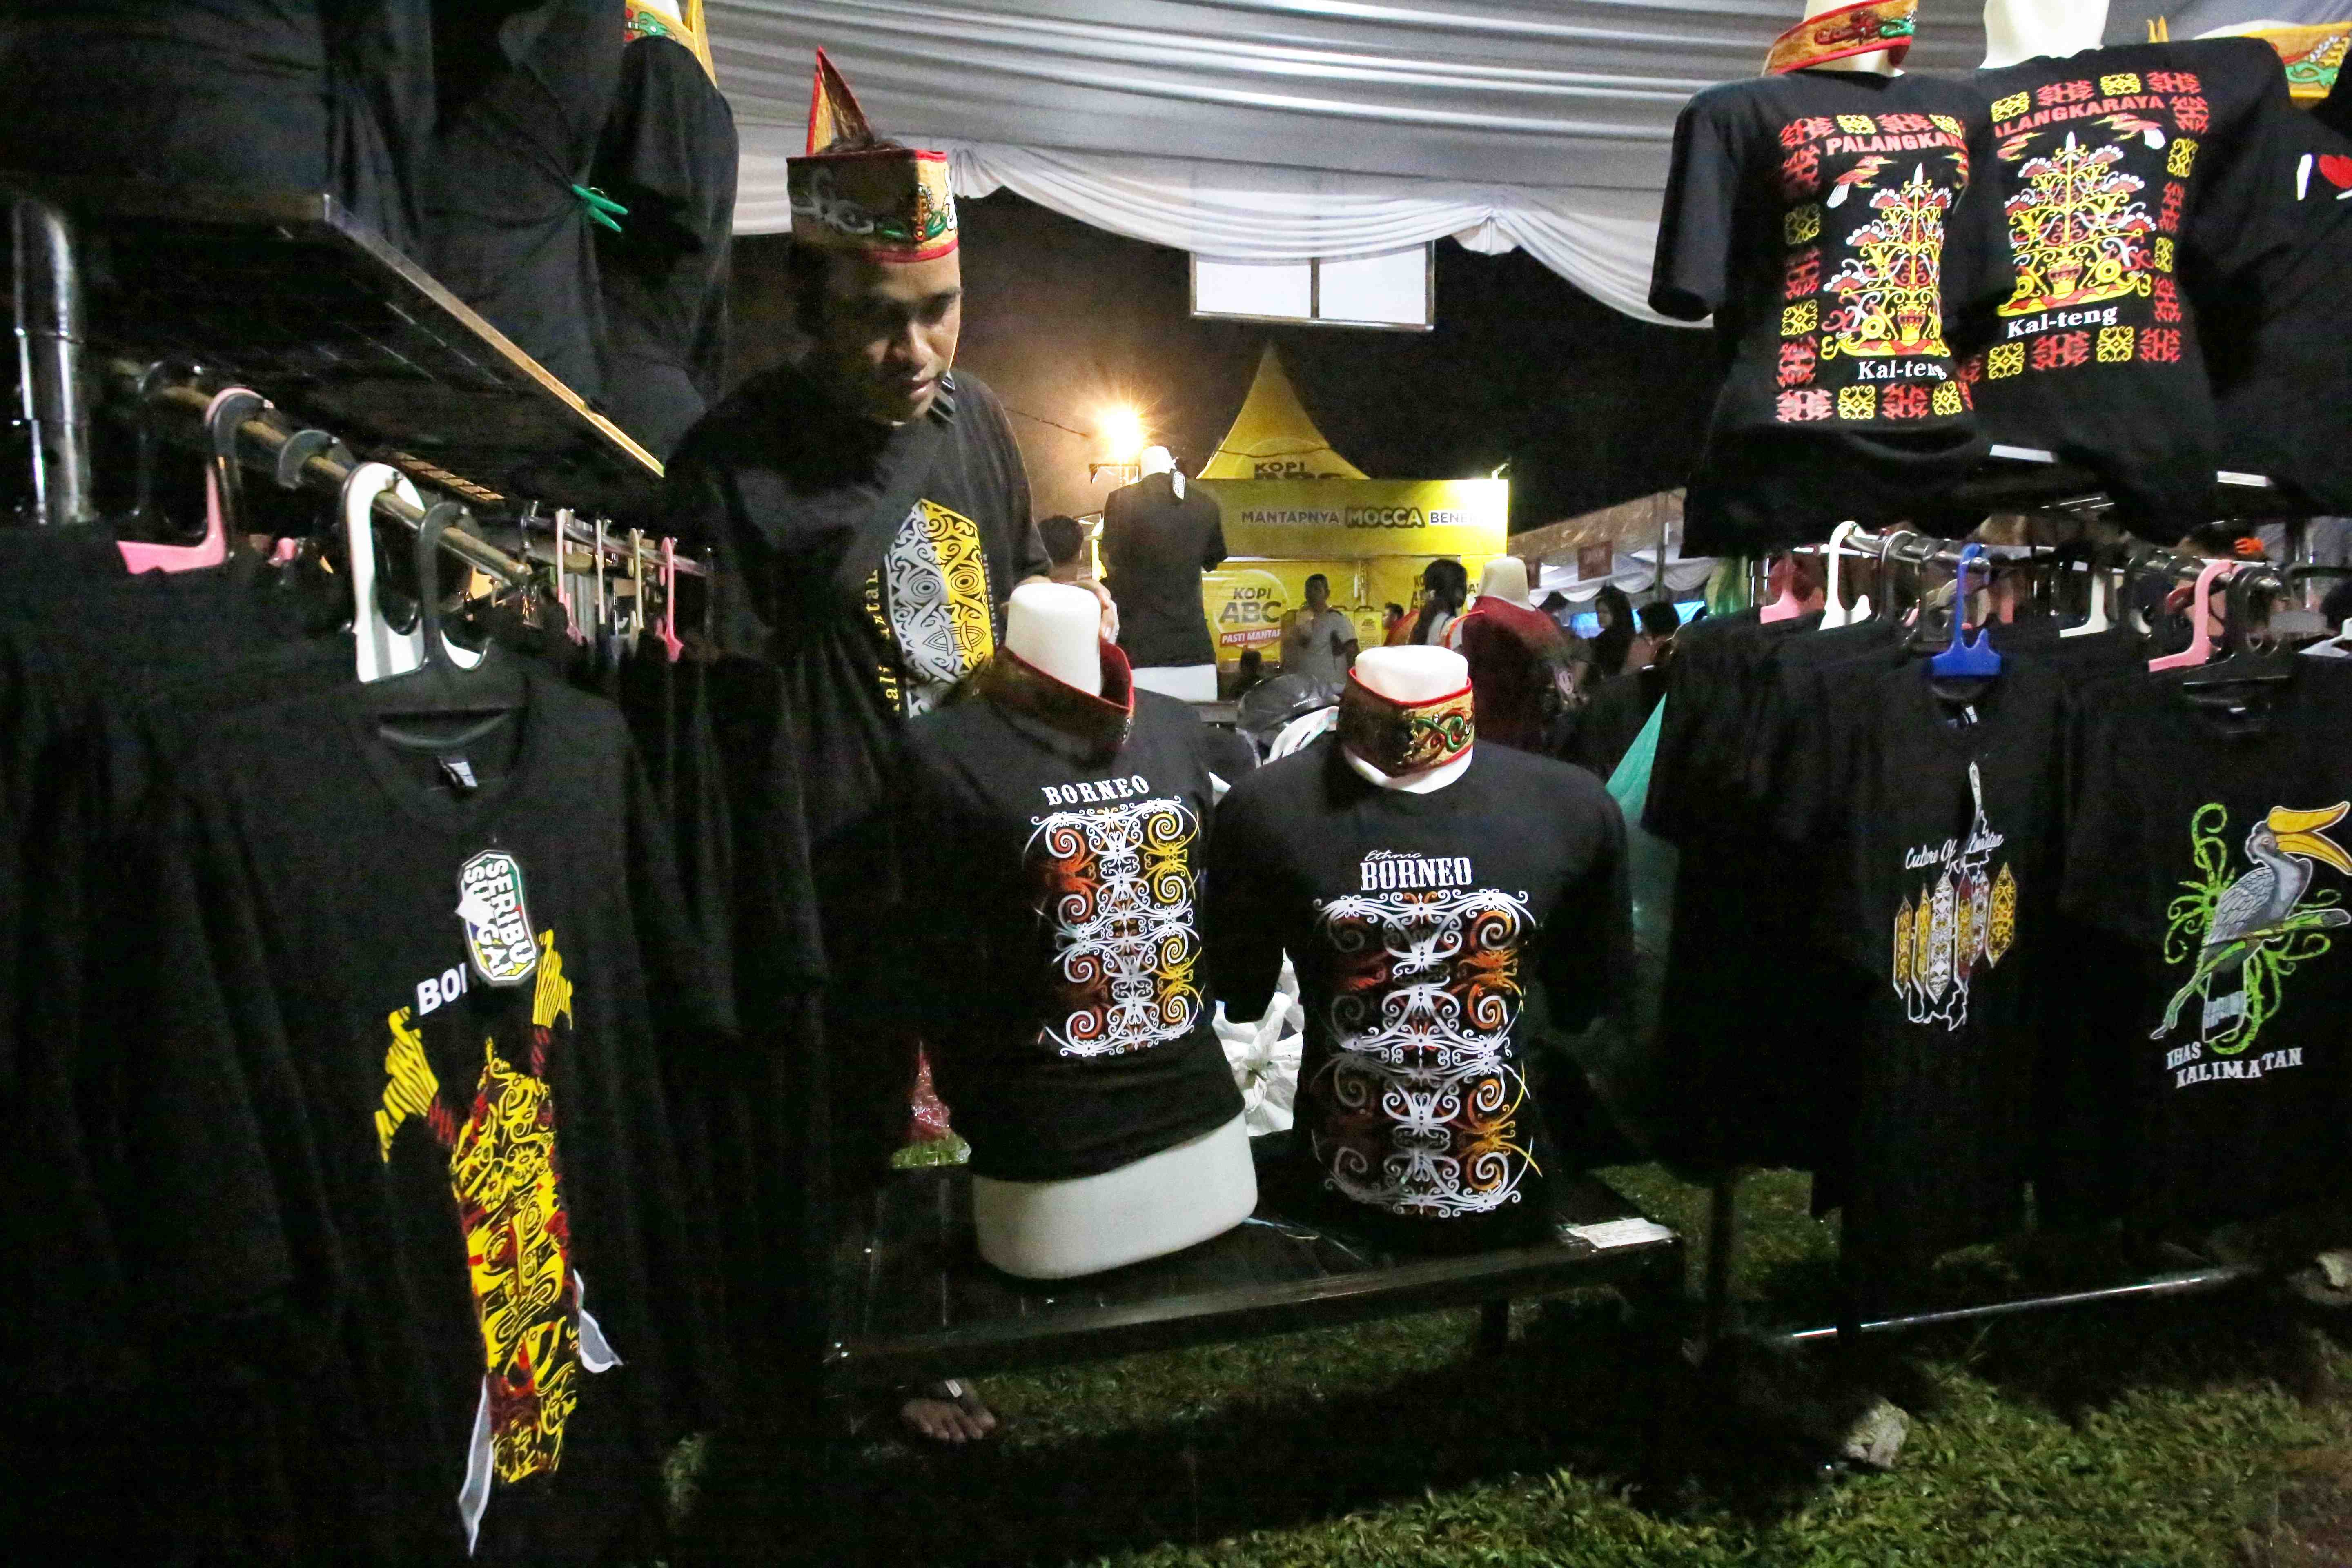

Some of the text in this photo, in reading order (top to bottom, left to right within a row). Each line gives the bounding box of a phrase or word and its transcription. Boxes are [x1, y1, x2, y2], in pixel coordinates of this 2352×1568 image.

[1994, 95, 2165, 138] LANGKARAYA
[2007, 306, 2118, 339] Kal-teng
[1254, 462, 1305, 473] KOPI
[1241, 508, 1475, 528] MANTAPNYA MOCCA BENE
[1234, 588, 1272, 599] KOPI
[1218, 601, 1281, 623] ABC
[1222, 633, 1245, 644] PASTI
[1041, 775, 1149, 805] BORNEO
[1365, 850, 1422, 861] Ethnic
[1360, 857, 1472, 891] BORNEO
[464, 866, 515, 976] SUGAI
[486, 860, 536, 964] SERIBU
